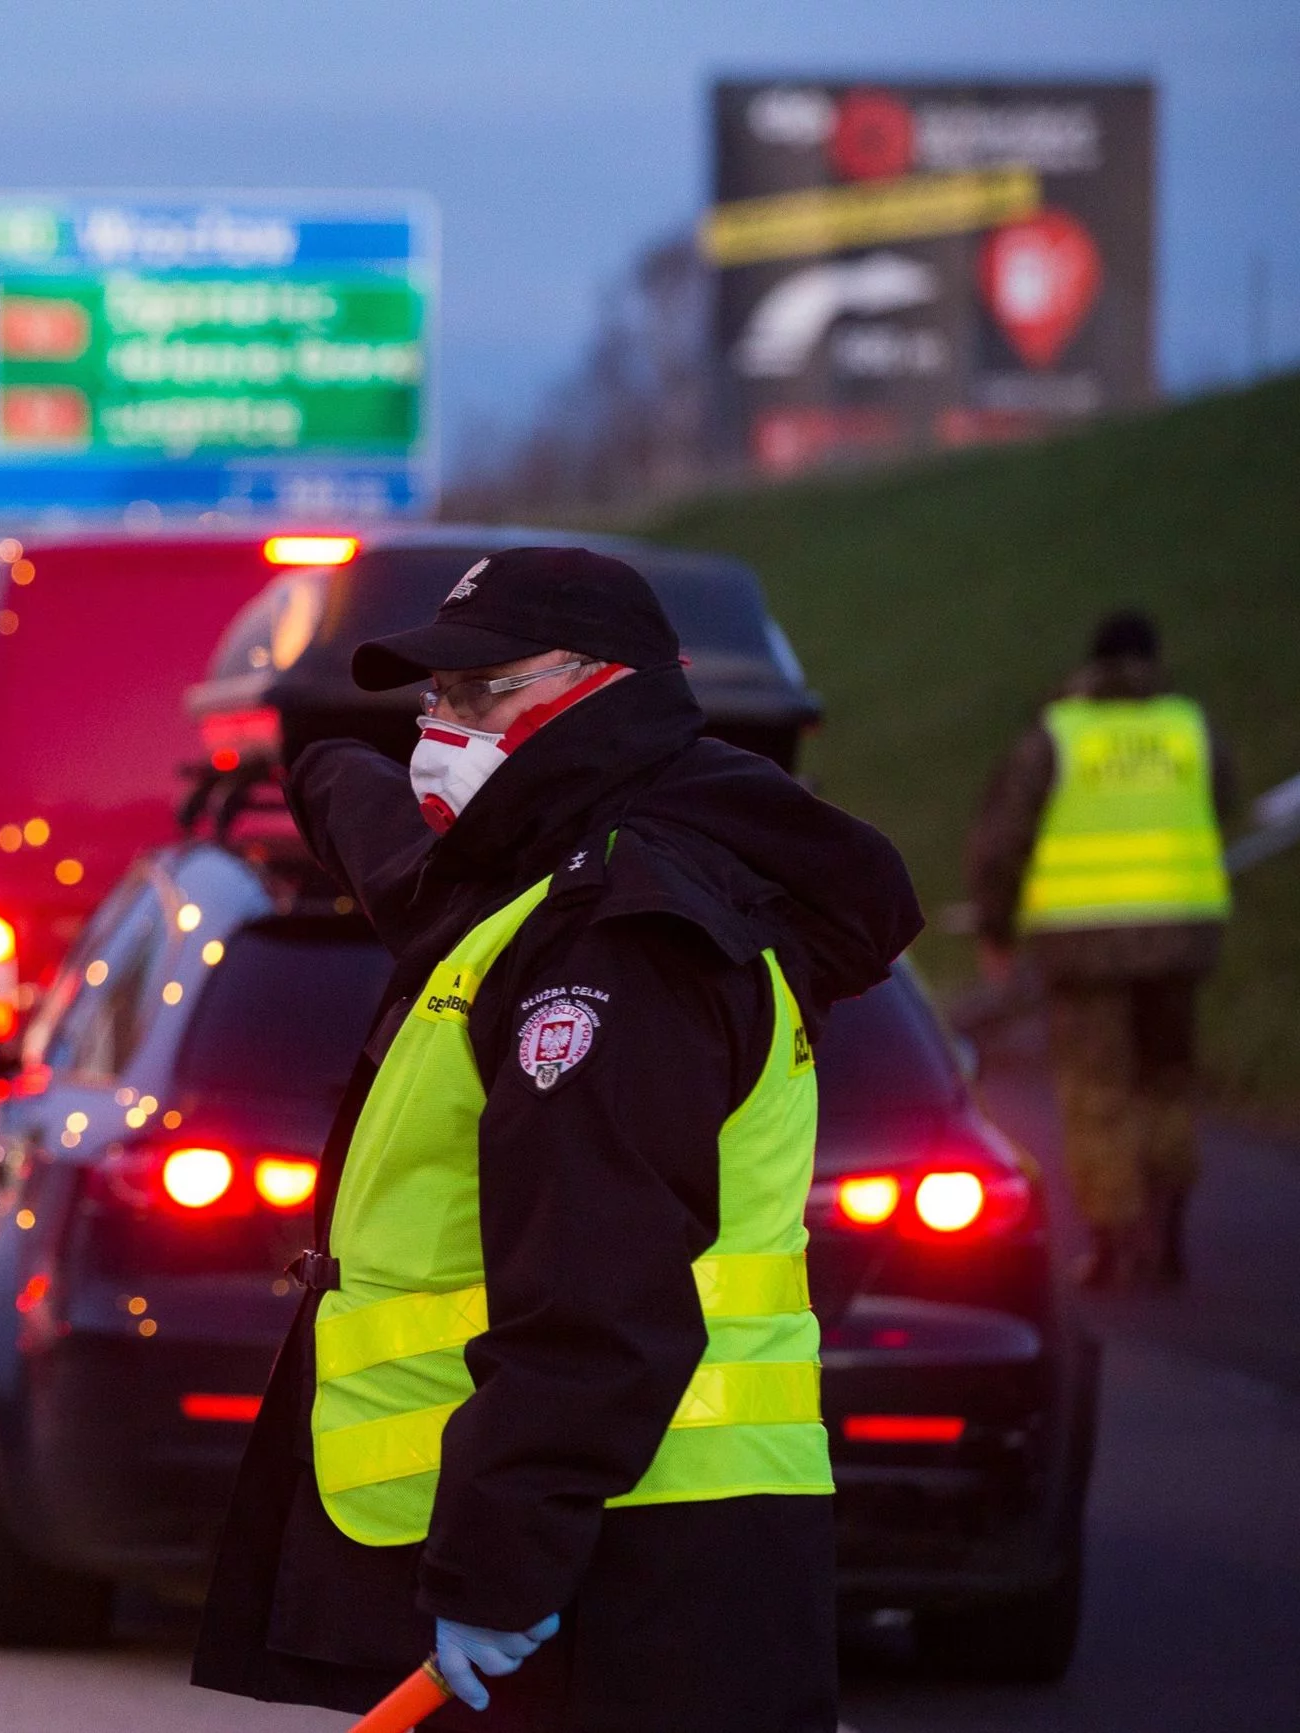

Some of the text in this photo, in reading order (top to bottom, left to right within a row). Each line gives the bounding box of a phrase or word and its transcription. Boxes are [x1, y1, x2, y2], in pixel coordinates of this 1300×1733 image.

[453, 974, 461, 987] A
[521, 986, 611, 1010] SŁUŻBA CELNA
[520, 1007, 590, 1069] RZECZPOSPOLITA POLSKA
